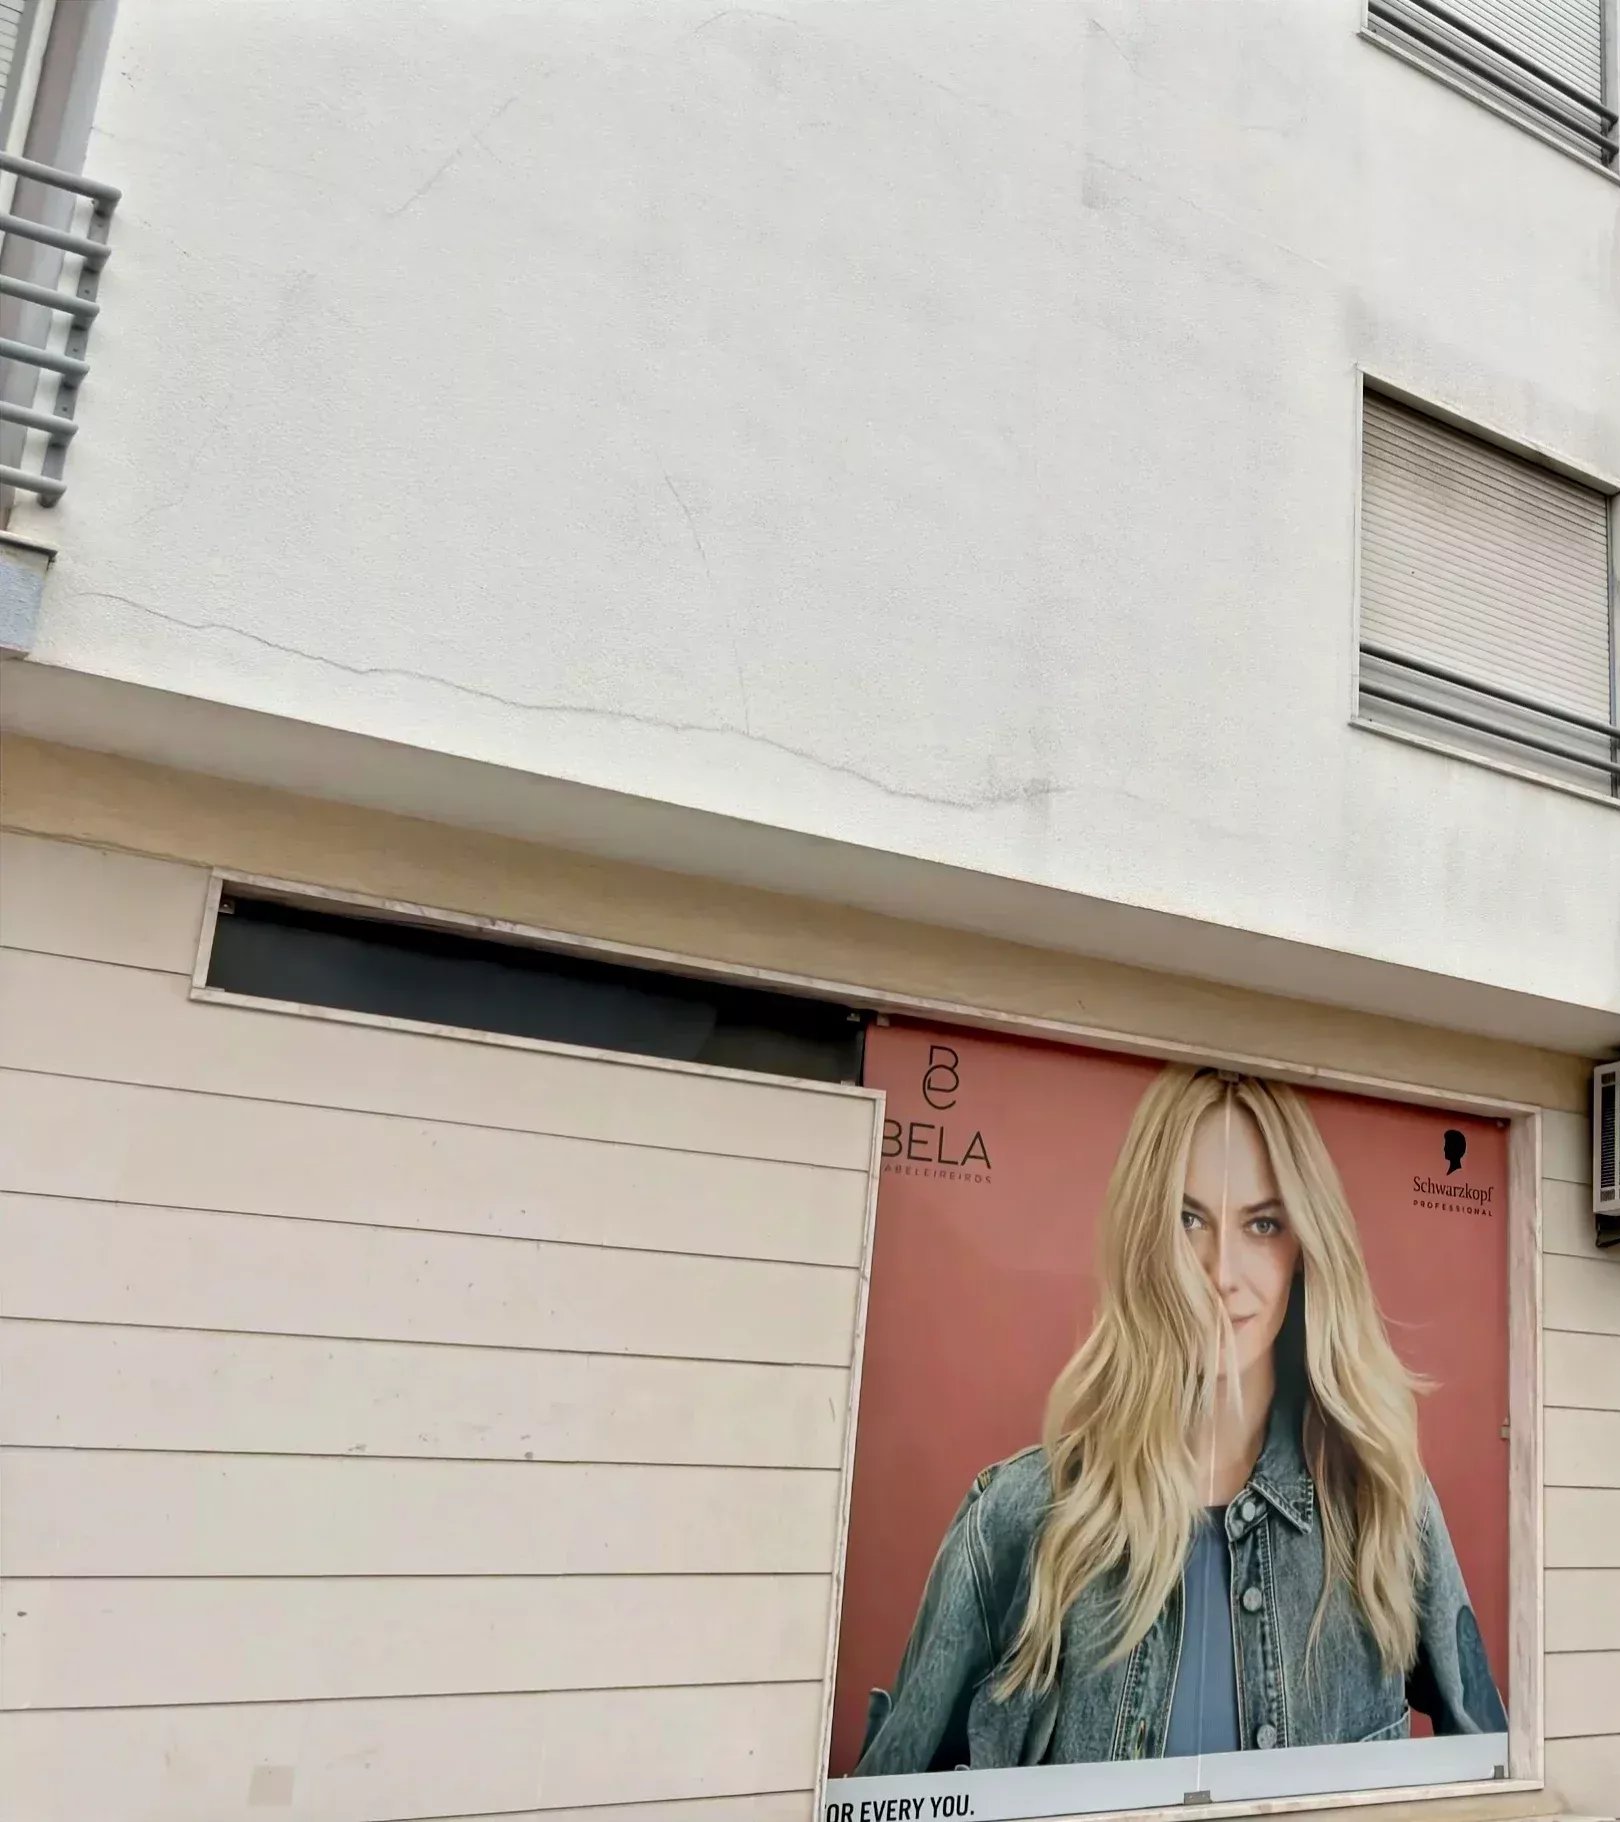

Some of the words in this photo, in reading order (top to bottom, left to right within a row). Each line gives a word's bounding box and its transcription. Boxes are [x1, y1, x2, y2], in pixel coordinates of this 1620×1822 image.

[881, 1118, 992, 1170] BELA
[884, 1163, 992, 1185] ABELEIREIROS
[1413, 1176, 1494, 1206] Schwarzkopf
[1413, 1199, 1493, 1217] PROFESSIONAL
[825, 1802, 854, 1822] OR
[860, 1797, 925, 1822] EVERY
[930, 1794, 975, 1819] YOU.
